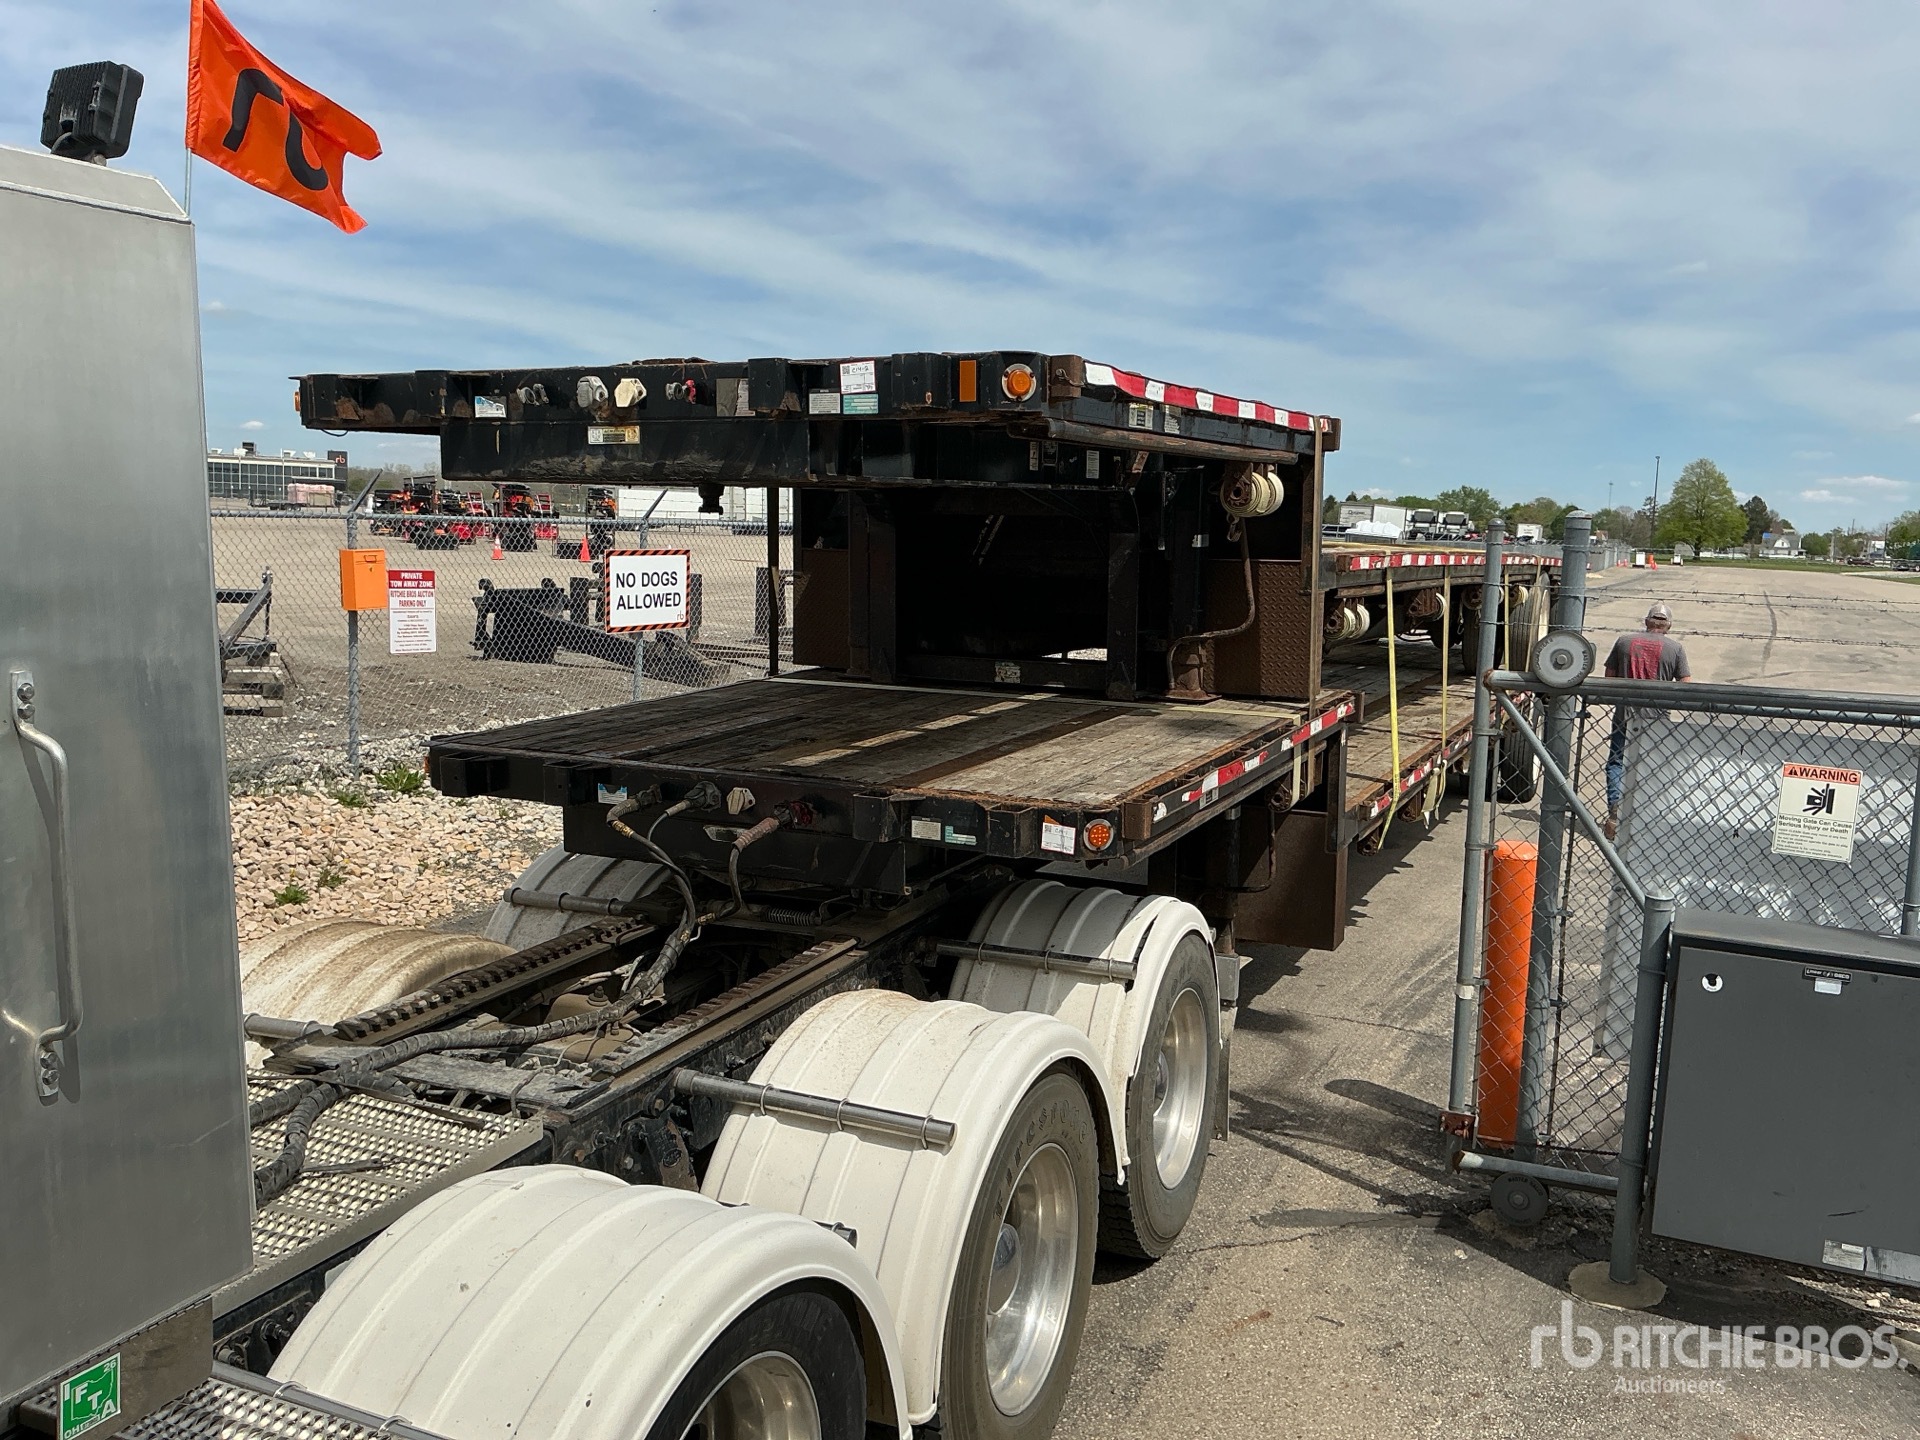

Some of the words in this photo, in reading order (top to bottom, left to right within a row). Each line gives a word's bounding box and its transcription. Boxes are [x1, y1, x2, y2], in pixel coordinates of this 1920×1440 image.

[336, 454, 346, 464] rb
[616, 572, 636, 588] NO
[642, 571, 678, 587] DOGS
[616, 592, 681, 610] ALLOWED
[676, 610, 684, 620] rb
[1799, 767, 1858, 782] WARNING
[1778, 814, 1802, 823] Moving
[104, 1360, 116, 1372] 26
